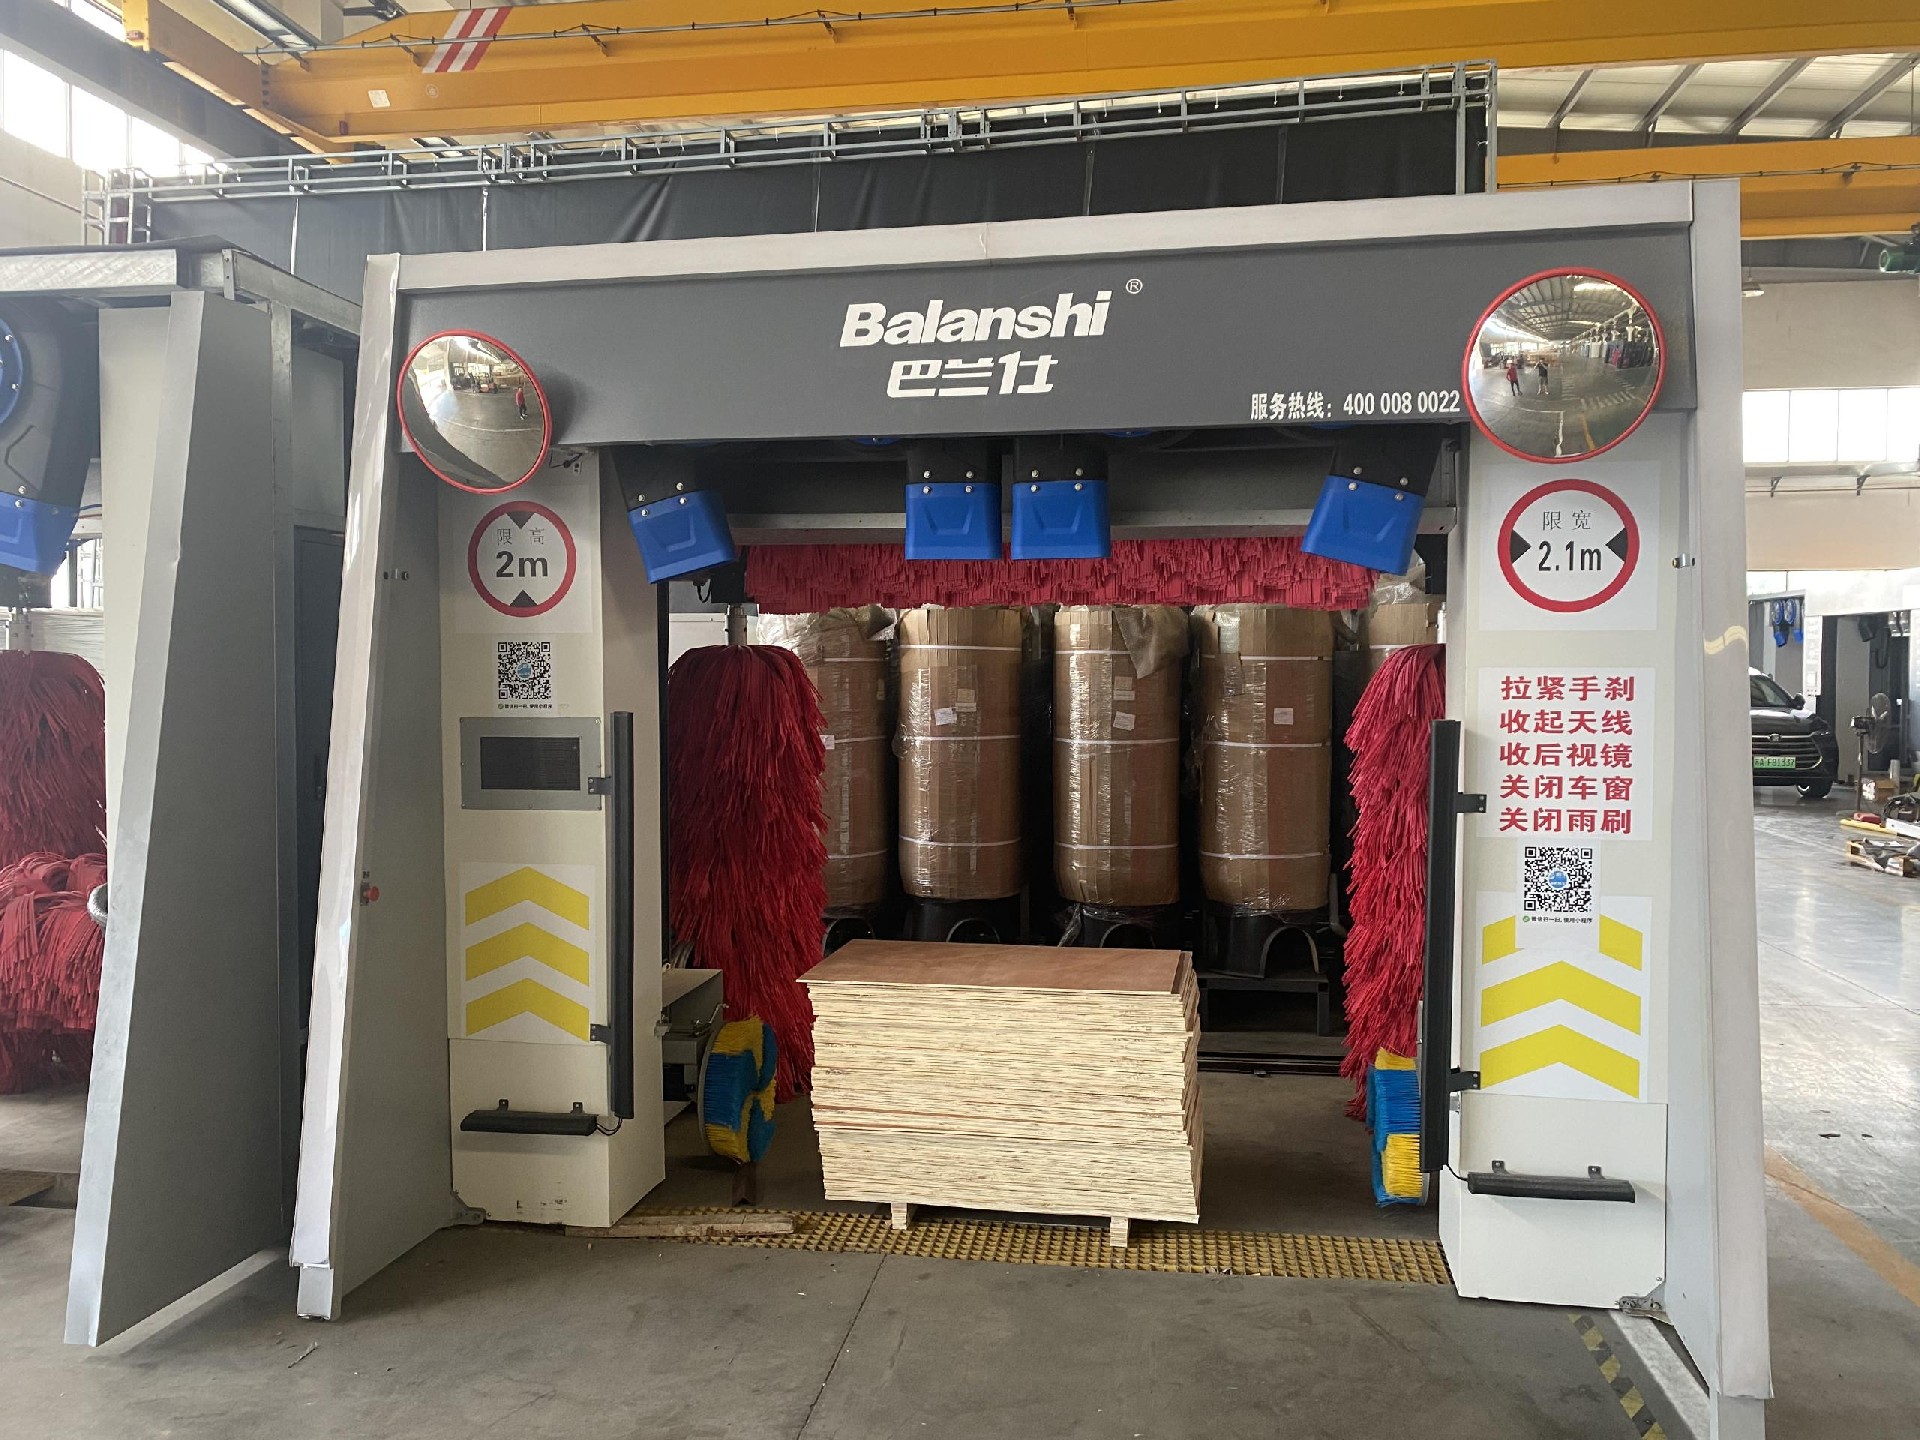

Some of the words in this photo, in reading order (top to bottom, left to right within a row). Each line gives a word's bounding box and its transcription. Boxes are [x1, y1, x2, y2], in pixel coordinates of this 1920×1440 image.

[840, 291, 1112, 347] Balanshi
[886, 351, 1058, 398] 巴兰仕
[1343, 393, 1374, 414] 400
[1380, 392, 1412, 414] 008
[1417, 390, 1460, 413] 0022
[496, 551, 548, 577] 2m
[1538, 541, 1602, 571] 2.1m
[1501, 675, 1635, 701] 拉紧手刹
[1500, 709, 1633, 735] 收起天线
[1500, 742, 1633, 768] 收后视镜
[1500, 774, 1633, 801] 关闭车窗
[1499, 807, 1632, 834] 关闭雨刷
